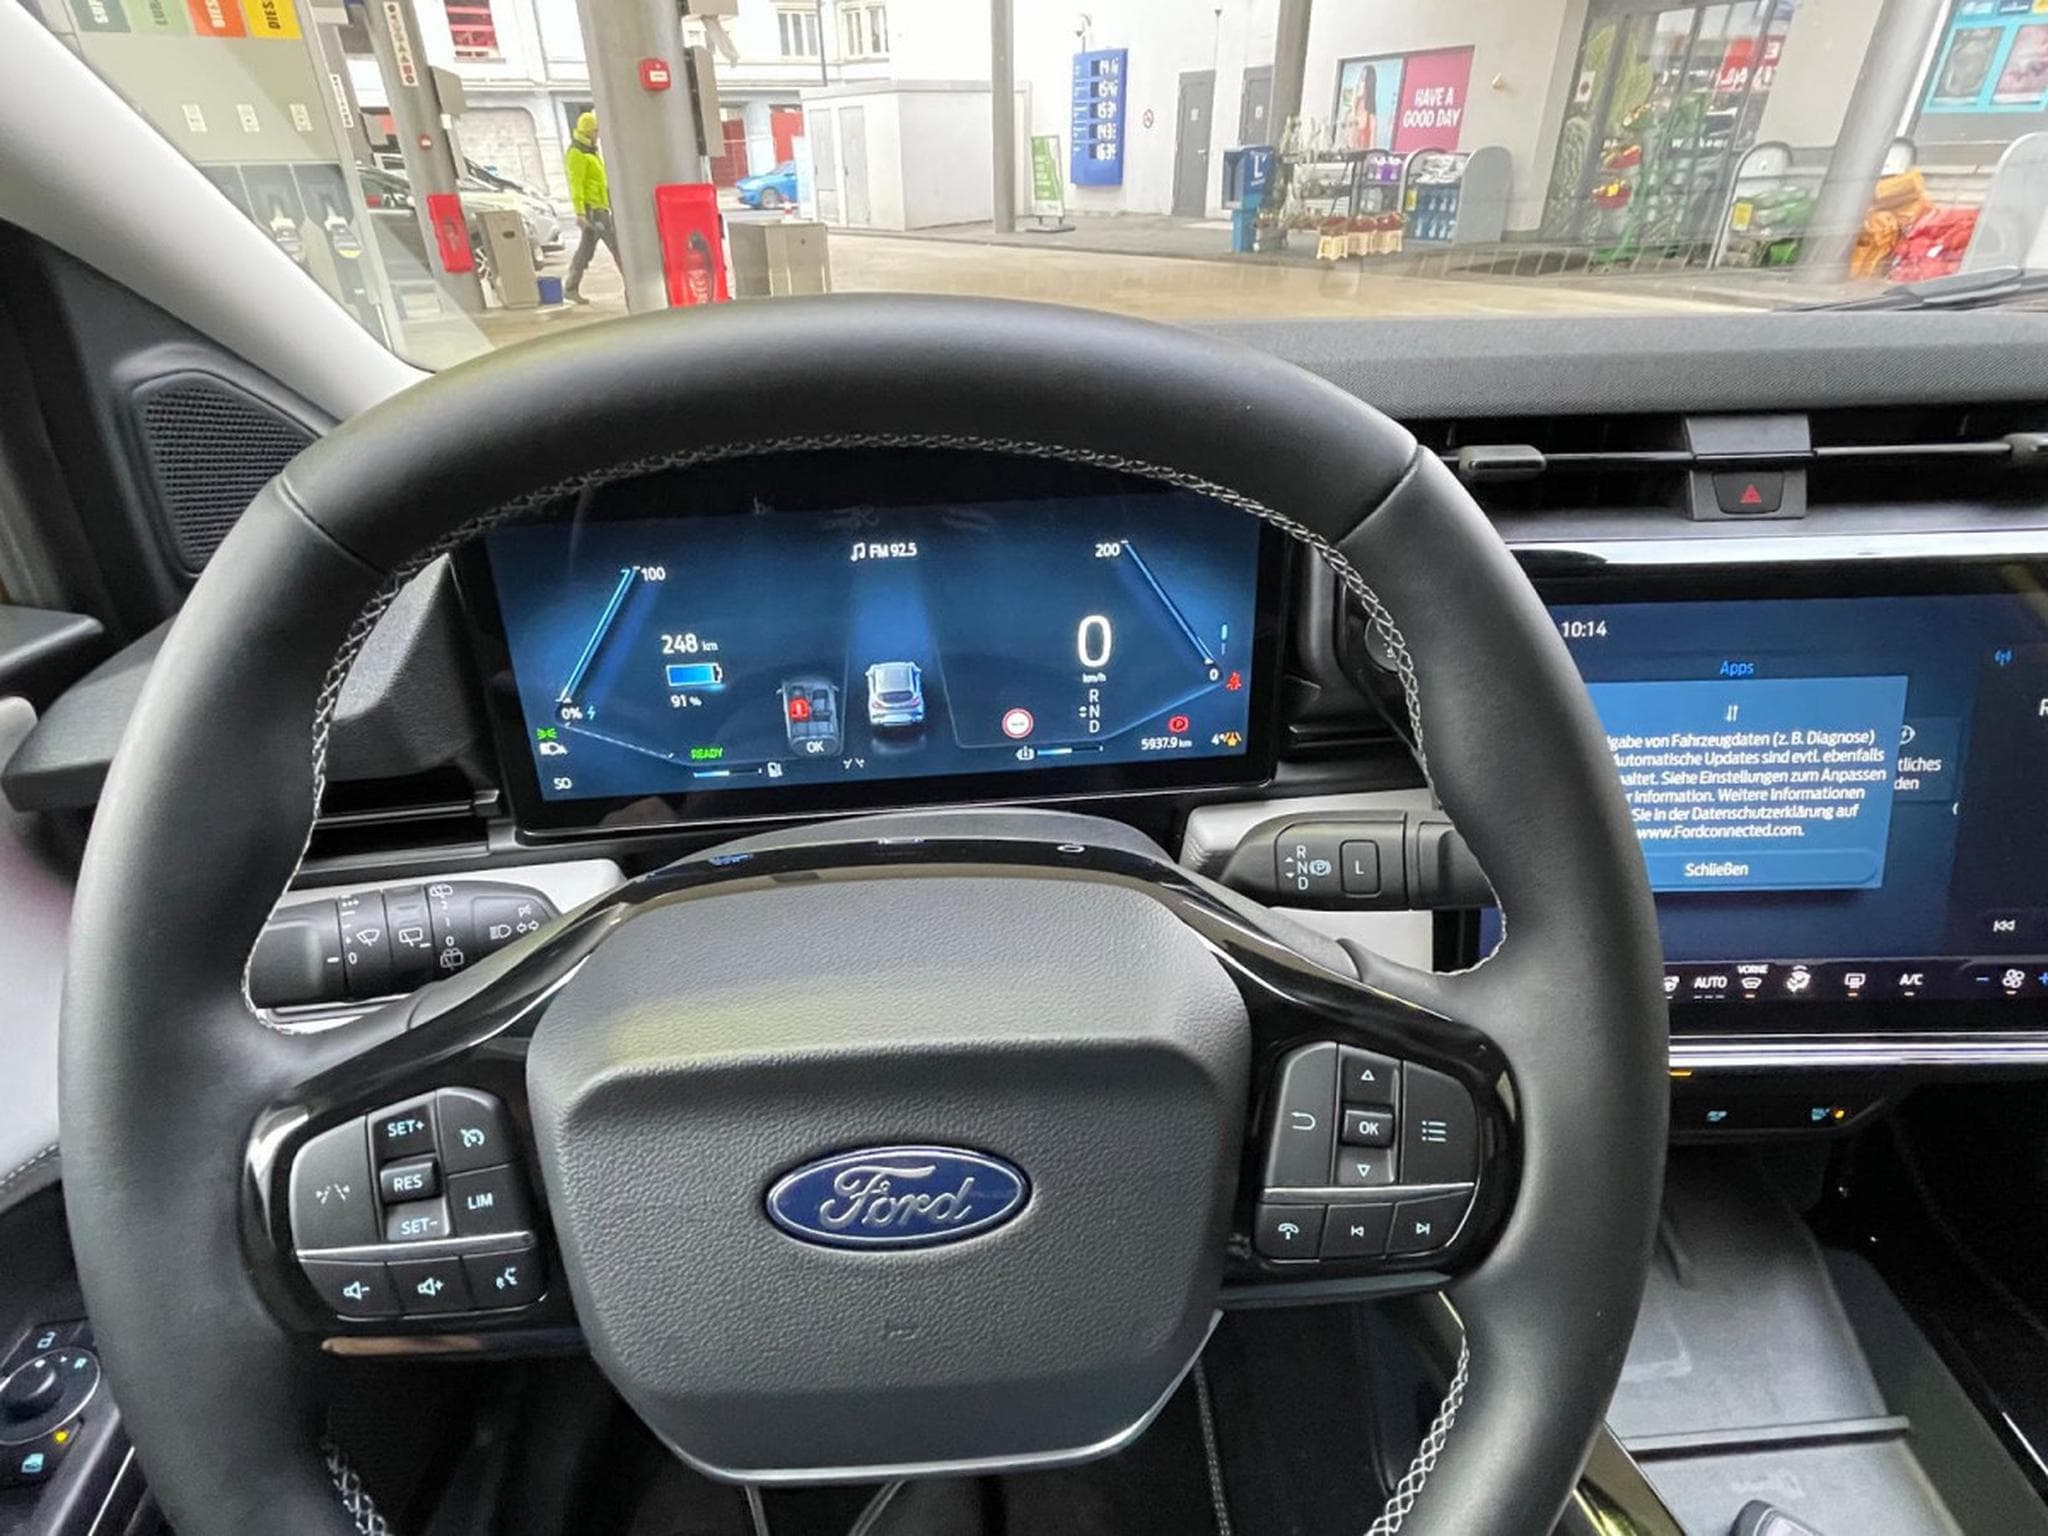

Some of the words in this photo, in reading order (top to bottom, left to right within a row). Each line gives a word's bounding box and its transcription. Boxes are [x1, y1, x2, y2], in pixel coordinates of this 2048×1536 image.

[1414, 86, 1445, 107] HAVE
[1444, 86, 1455, 106] A
[1402, 109, 1435, 129] GOOD
[1435, 107, 1462, 128] DAY
[869, 543, 889, 558] FM
[890, 542, 917, 557] 92.5
[1095, 543, 1120, 557] 200
[641, 566, 666, 581] 100
[1561, 621, 1607, 637] 10:14
[661, 633, 698, 654] 248
[702, 641, 719, 652] km
[1078, 614, 1112, 667] 0
[1209, 668, 1219, 681] 0
[1720, 660, 1754, 676] Apps
[1082, 672, 1106, 683] km/h
[671, 695, 687, 708] 91
[689, 696, 702, 706] %
[1089, 688, 1099, 702] R
[561, 706, 583, 720] 0%
[1089, 704, 1100, 718] N
[1089, 719, 1100, 733] D
[1141, 736, 1178, 750] 5937.9
[1179, 739, 1192, 749] km
[1645, 736, 1669, 748] von
[1671, 732, 1770, 748] Fahrzeugdaten
[1791, 731, 1804, 745] B.
[1806, 729, 1875, 746] Diagnose)
[691, 747, 723, 759] READY
[806, 740, 824, 753] OK
[1704, 750, 1760, 767] Updates
[1761, 749, 1790, 764] sind
[1791, 748, 1820, 763] evtl.
[1823, 747, 1885, 762] ebenfalls
[1661, 770, 1698, 785] Siehe
[1700, 768, 1789, 786] Einstellungen
[1790, 771, 1820, 783] zum
[1821, 768, 1887, 784] Anpassen
[1894, 776, 1920, 790] den
[1634, 790, 1716, 804] Information.
[1718, 788, 1768, 802] Weitere
[1770, 787, 1866, 801] Informationen
[1632, 807, 1652, 821] Sie
[1653, 807, 1667, 820] in
[1668, 806, 1690, 820] der
[1691, 804, 1834, 821] Datenschutzerklärung
[1835, 803, 1860, 818] auf
[1636, 823, 1805, 839] www.Fordconnected.com.
[1296, 845, 1306, 859] R
[1297, 861, 1309, 875] N
[1355, 860, 1365, 874] L
[1683, 862, 1749, 877] Schließen
[1298, 877, 1309, 890] D
[1737, 964, 1769, 974] VORNE
[1694, 976, 1728, 989] AUTO
[1899, 973, 1924, 986] A/C
[387, 1119, 425, 1138] SET+
[1359, 1121, 1379, 1136] OK
[393, 1173, 424, 1193] RES
[467, 1192, 493, 1210] LIM
[819, 1164, 975, 1230] Ford
